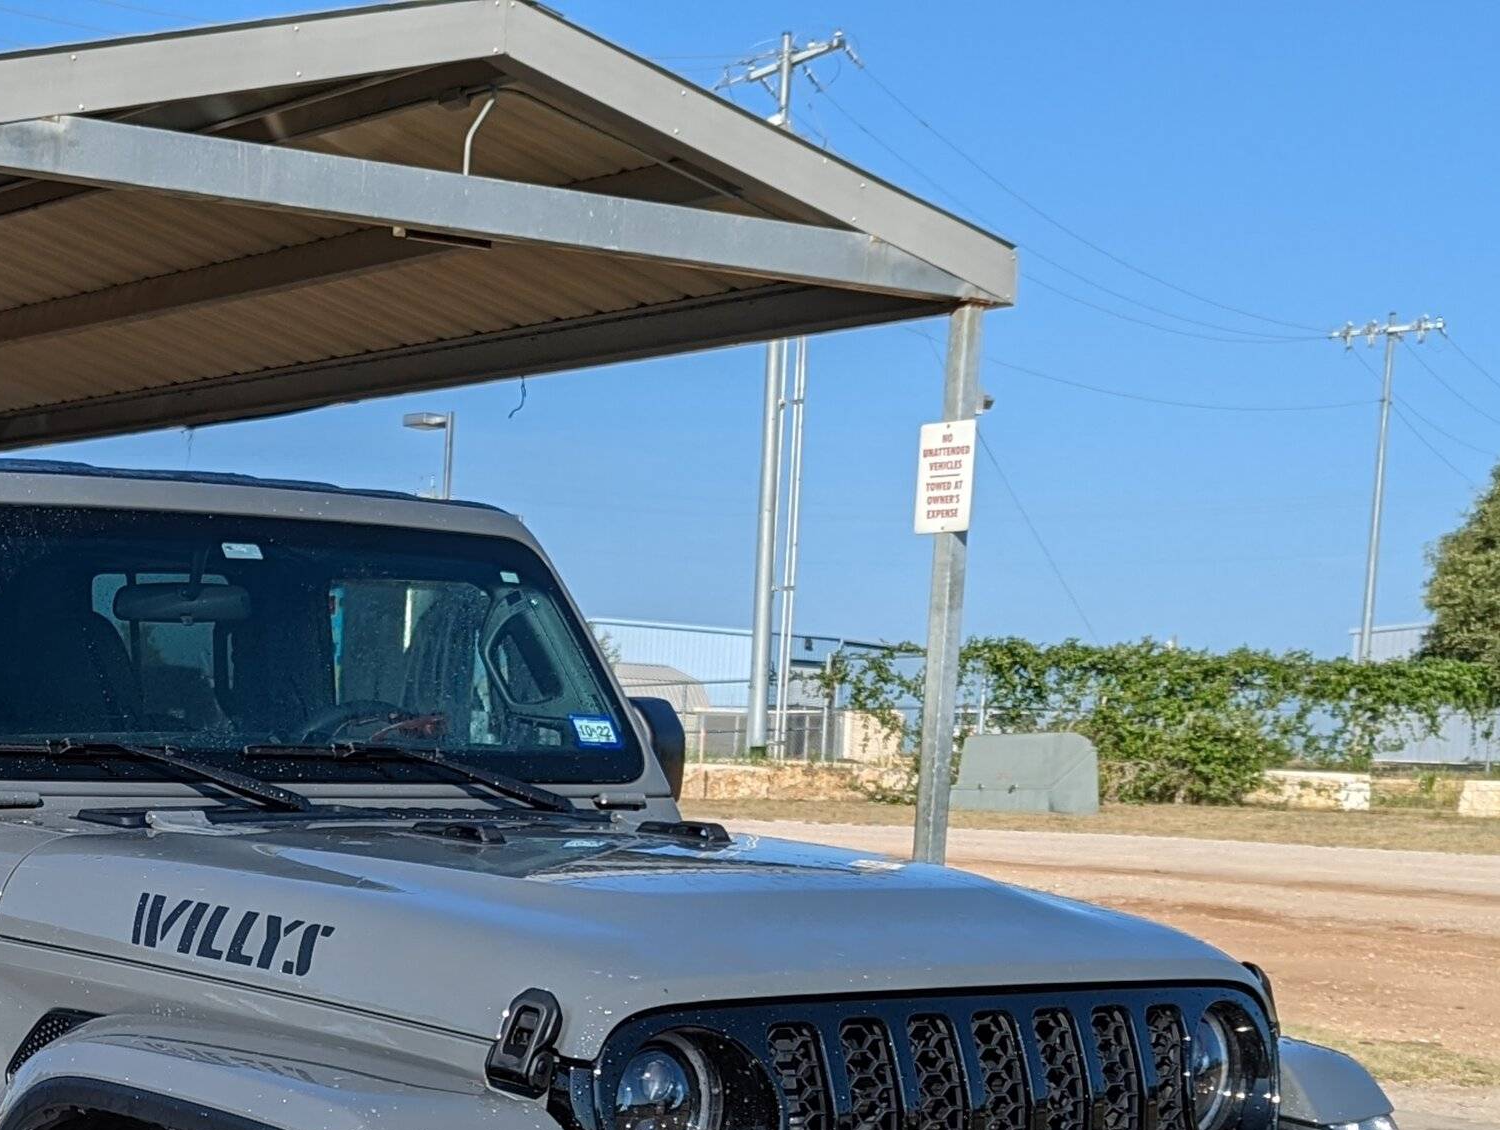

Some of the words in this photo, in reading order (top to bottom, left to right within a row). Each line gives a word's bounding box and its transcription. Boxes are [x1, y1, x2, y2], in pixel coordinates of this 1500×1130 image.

[942, 433, 953, 443] NO
[923, 445, 970, 458] UNATTENDED
[929, 460, 962, 471] VEHICLES
[926, 481, 952, 492] TOWED
[954, 480, 963, 490] AT
[927, 508, 958, 519] EXPENSE
[132, 892, 336, 976] WILLYS
